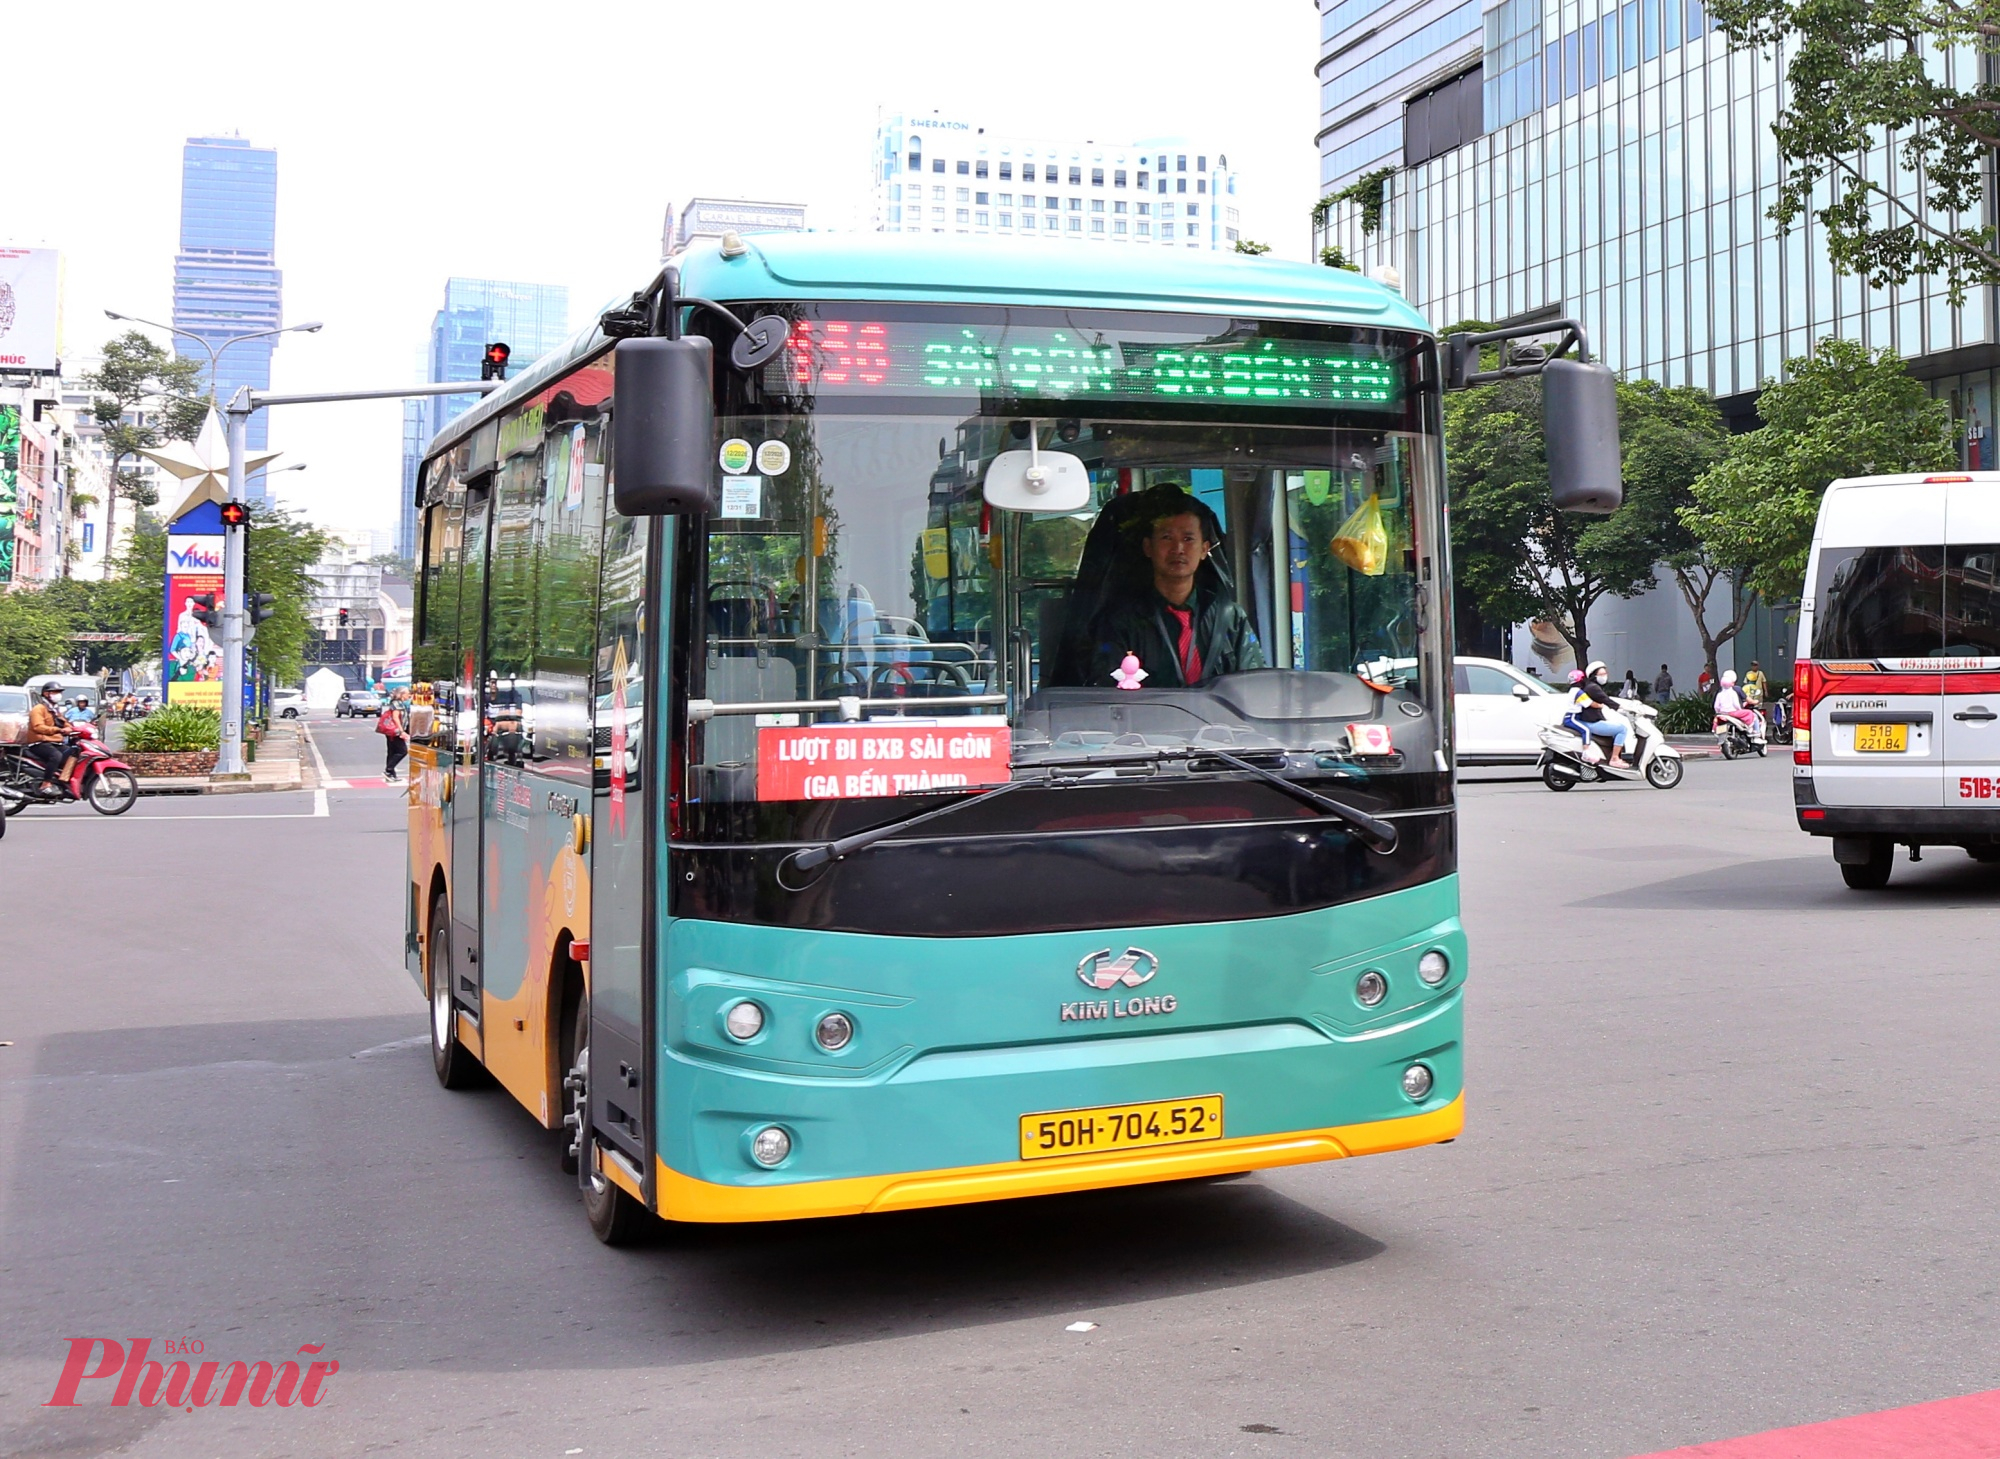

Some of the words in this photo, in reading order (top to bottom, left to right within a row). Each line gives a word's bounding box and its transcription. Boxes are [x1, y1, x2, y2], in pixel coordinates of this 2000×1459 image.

[910, 119, 969, 131] SHERATON
[703, 212, 762, 224] CARAVELLE
[766, 216, 799, 226] HOTEL
[170, 542, 220, 568] Vikki
[1835, 699, 1888, 709] HYUNDAI
[1869, 725, 1893, 737] 51B
[779, 735, 831, 766] LƯỢT
[835, 738, 857, 761] ĐI
[862, 738, 904, 761] BXB
[910, 733, 944, 760] SÀI
[949, 732, 992, 760] GÒN
[1860, 738, 1900, 750] 221.84
[804, 775, 841, 801] (GA
[845, 767, 888, 797] BẾN
[1959, 776, 2000, 799] 51B-
[1061, 1000, 1109, 1022] KIM
[1113, 994, 1179, 1019] LONG
[1039, 1106, 1205, 1150] 50H-704.52
